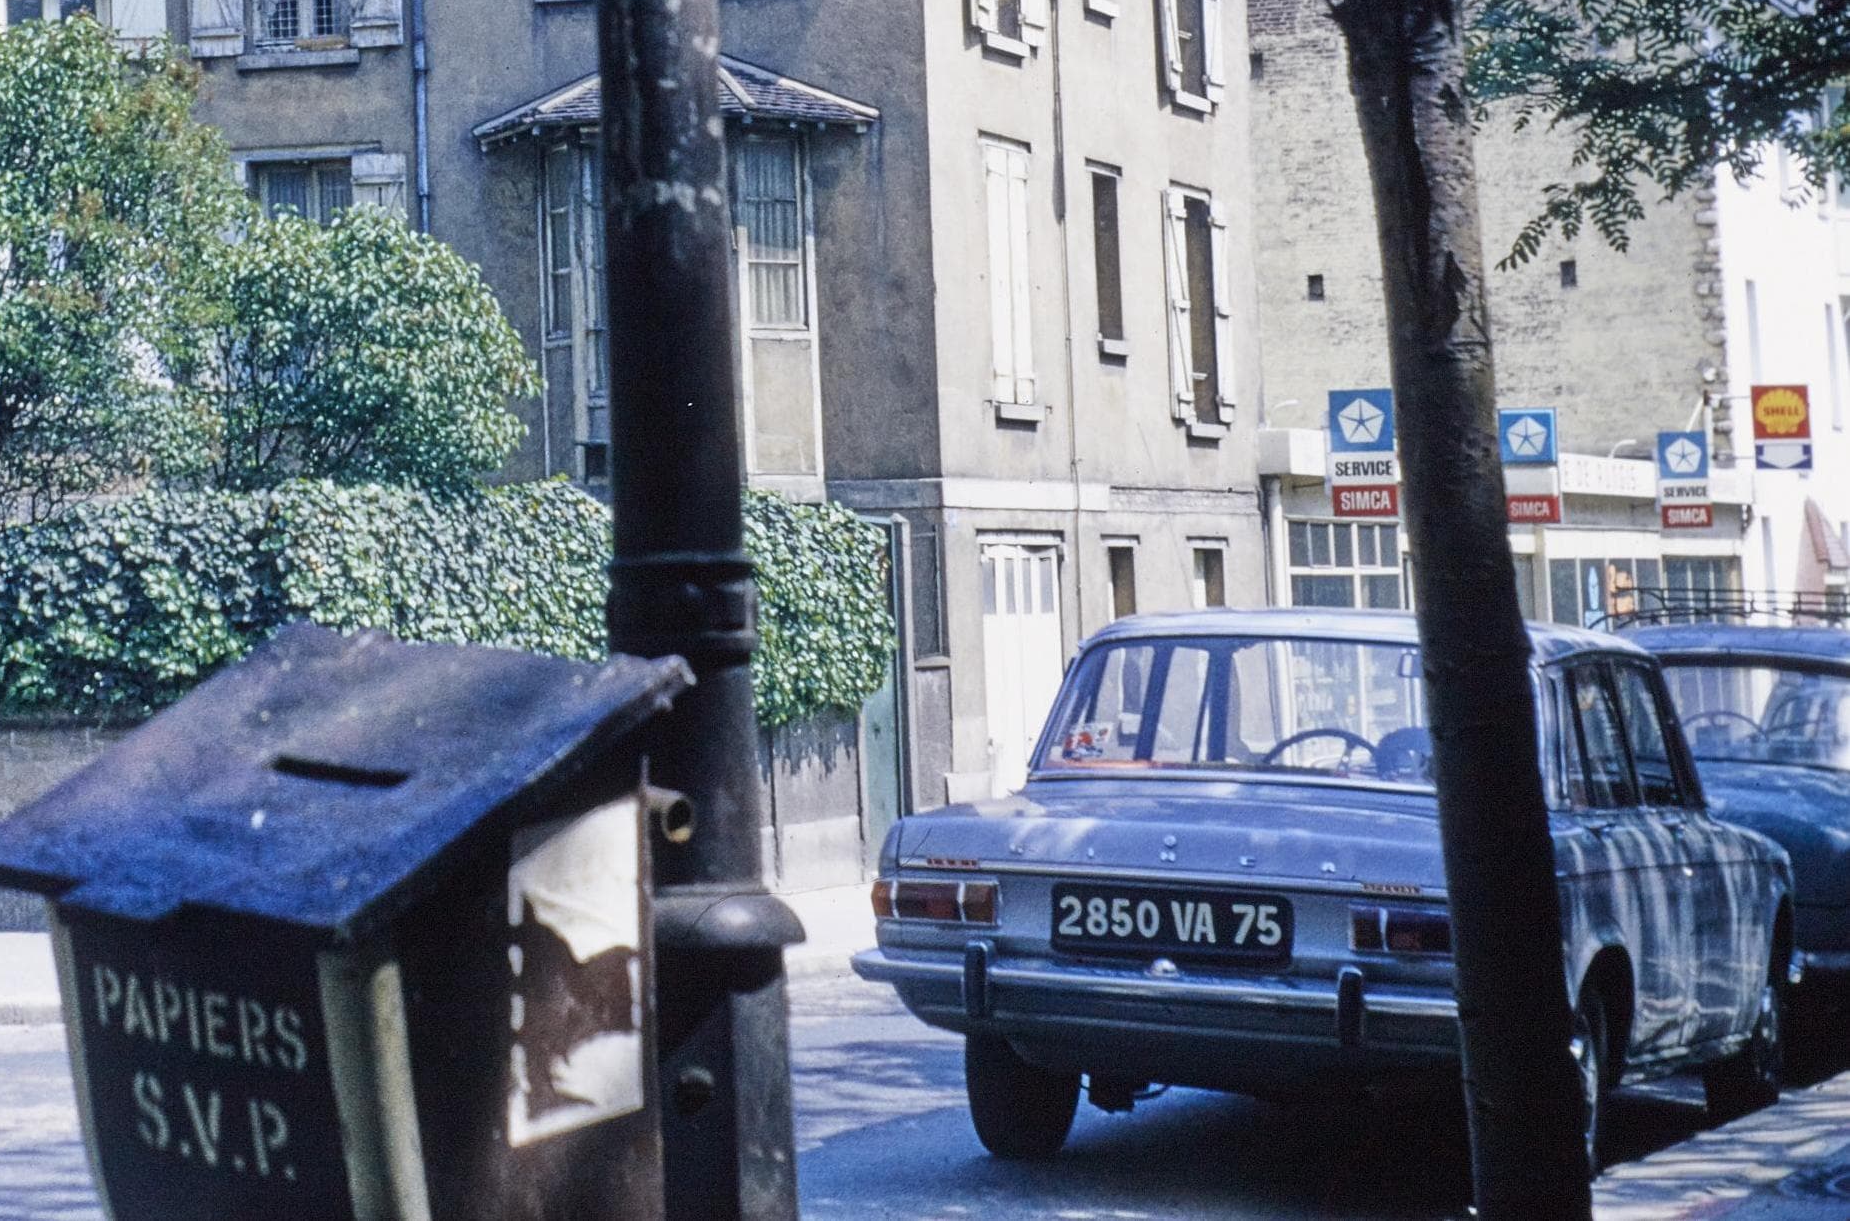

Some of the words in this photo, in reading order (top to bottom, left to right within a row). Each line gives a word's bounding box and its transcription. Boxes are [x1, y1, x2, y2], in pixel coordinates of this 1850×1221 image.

[1763, 406, 1800, 417] SHELL
[1335, 460, 1393, 477] SERVICE
[1663, 485, 1708, 498] SERVICE
[1340, 490, 1392, 511] SIMCA
[1509, 500, 1550, 517] SIMCA
[1667, 508, 1709, 524] SIMCA
[1058, 895, 1160, 939] 2850
[1170, 900, 1217, 944] VA
[1232, 904, 1282, 946] 75
[94, 966, 307, 1070] PAPIERS
[134, 1071, 296, 1180] S.V.P.
